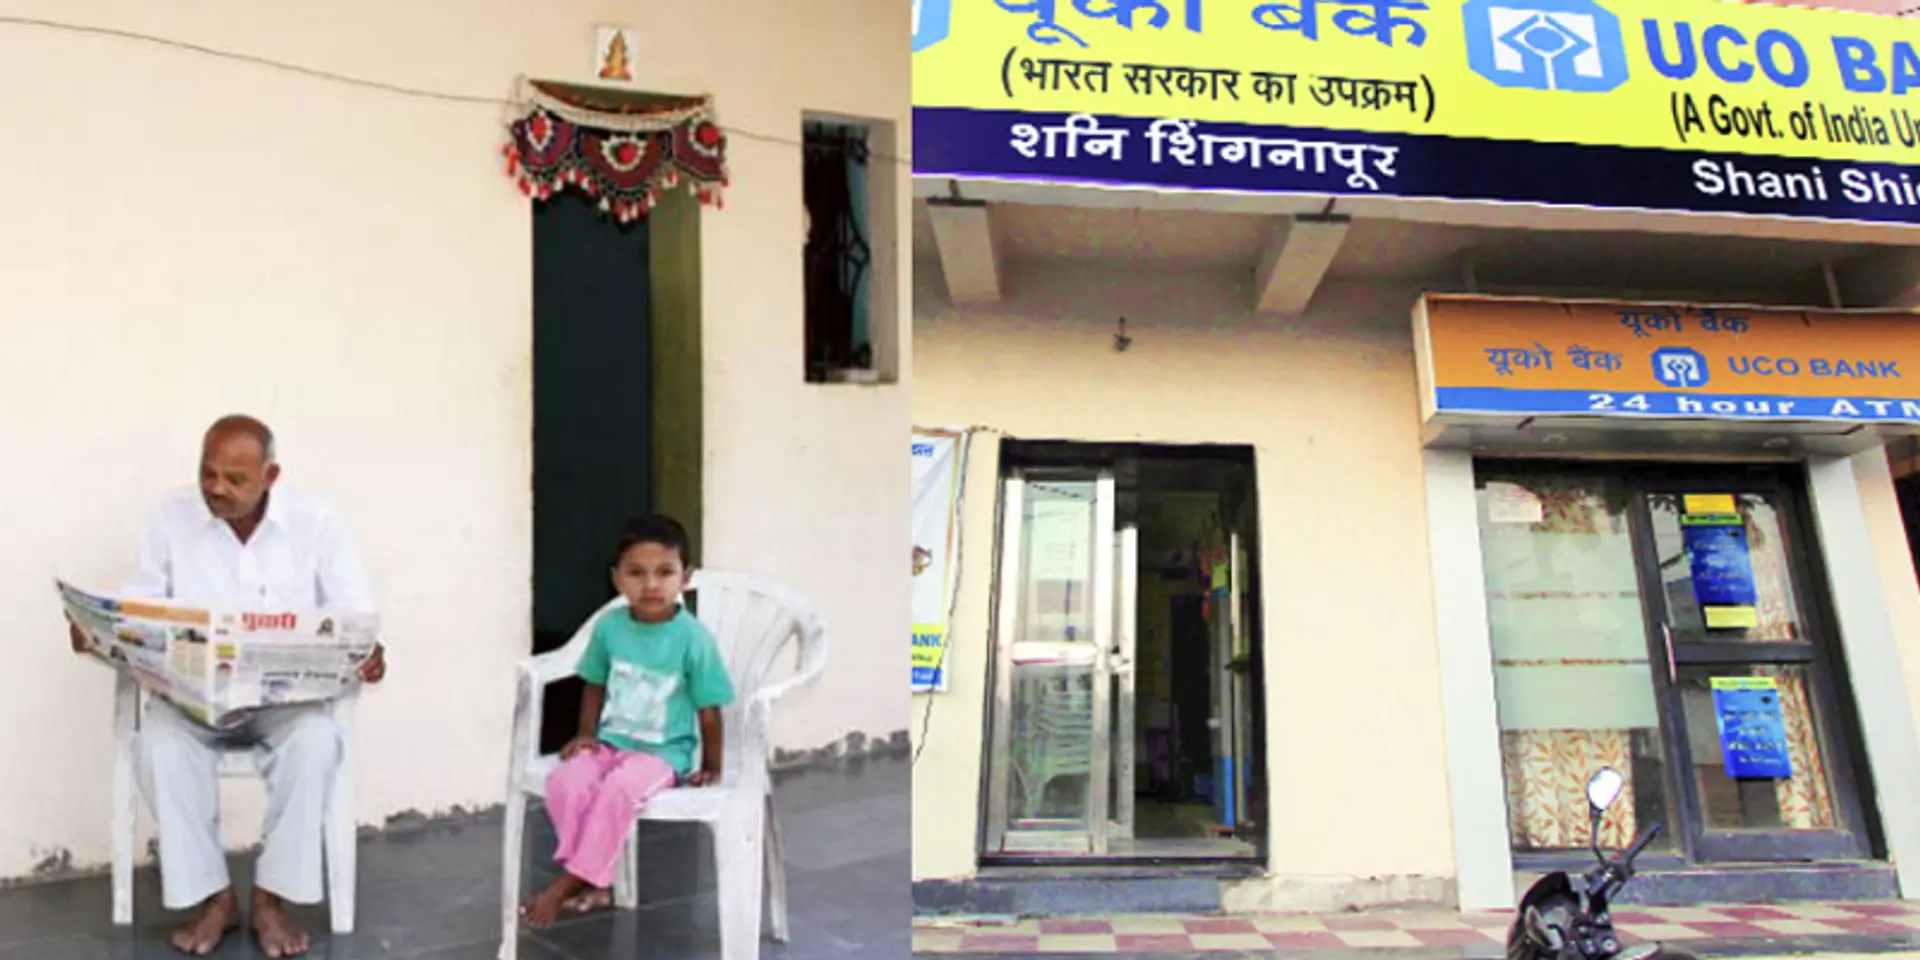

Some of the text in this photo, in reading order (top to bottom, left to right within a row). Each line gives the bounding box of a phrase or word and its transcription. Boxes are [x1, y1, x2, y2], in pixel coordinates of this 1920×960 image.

[1642, 18, 1809, 88] UCO
[1002, 46, 1435, 123] (भारत सरकार का उपक्रम)
[1671, 92, 1704, 142] (A
[1709, 94, 1784, 139] Govt.
[1789, 101, 1817, 140] of
[1819, 102, 1890, 145] India
[1010, 114, 1400, 190] शनि शिंगनापूर
[1692, 159, 1828, 200] Shani
[1484, 341, 1555, 375] यूको
[1728, 356, 1902, 378] UCO BANK
[1588, 394, 1652, 412] 24
[1677, 396, 1795, 415] hour
